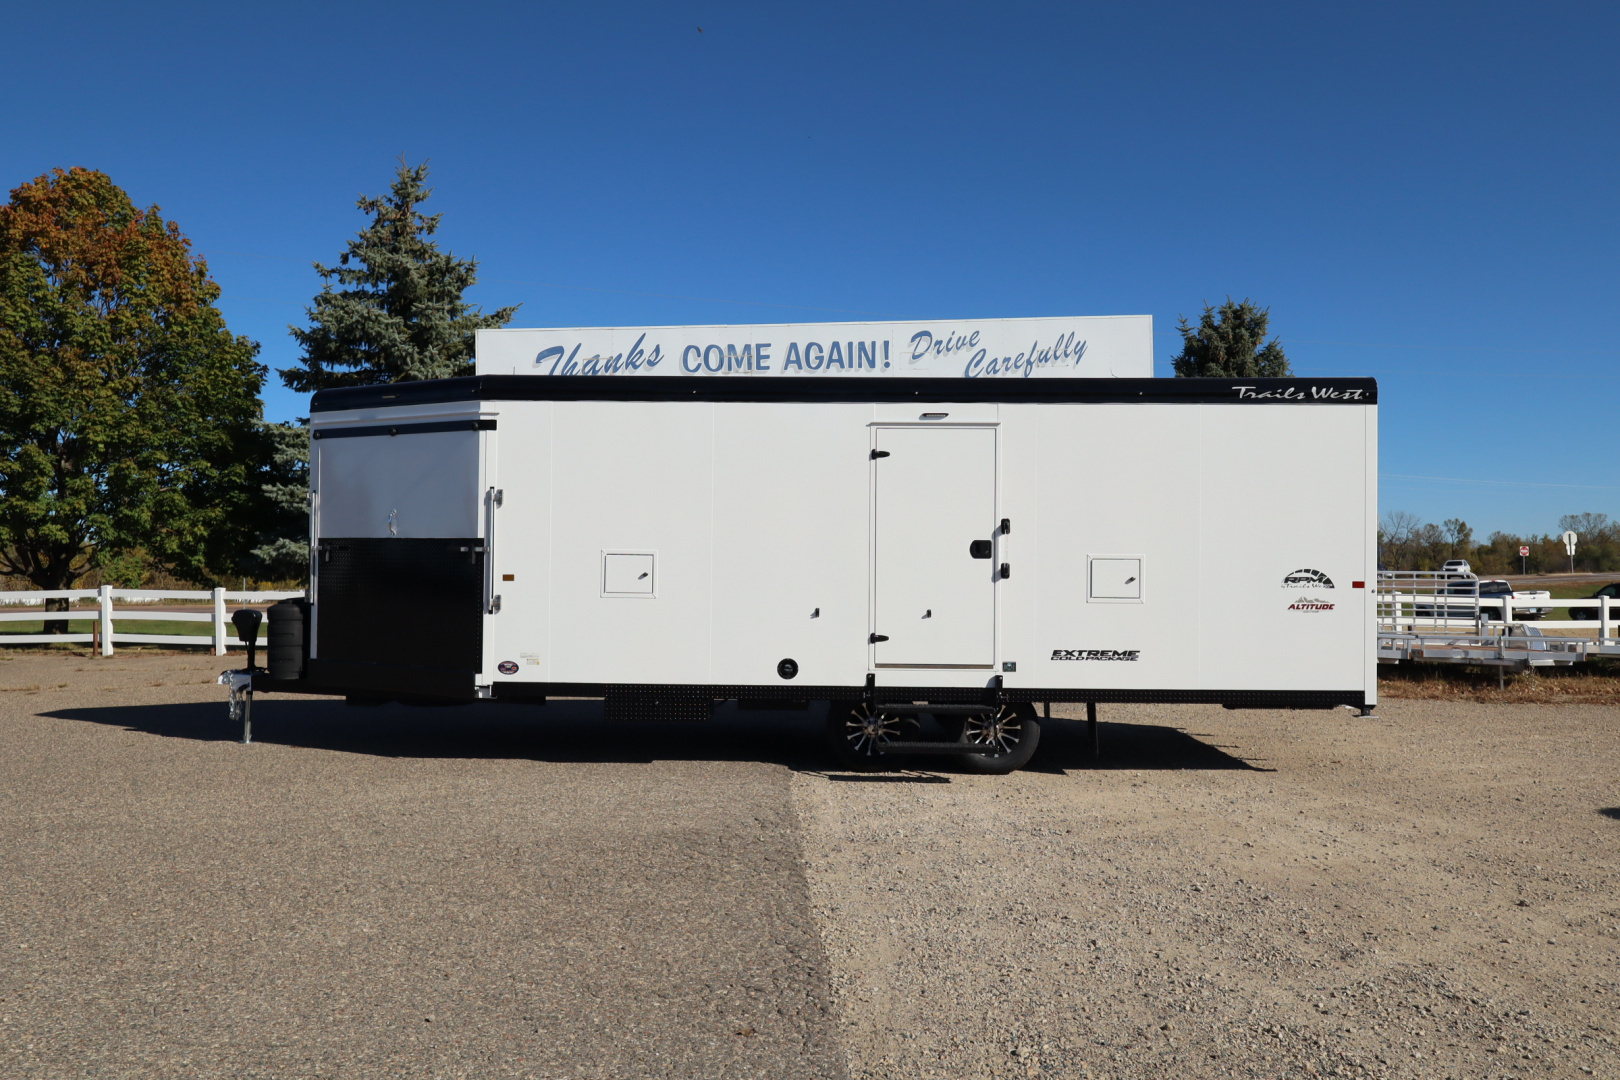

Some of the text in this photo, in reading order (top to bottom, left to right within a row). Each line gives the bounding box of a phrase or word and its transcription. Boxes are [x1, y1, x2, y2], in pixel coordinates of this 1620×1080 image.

[535, 333, 890, 376] Thanks COME AGAIN!
[910, 330, 980, 360] Drive
[964, 331, 1088, 378] Carefully
[1232, 386, 1363, 400] Trails West
[1284, 576, 1325, 584] RPM
[1052, 649, 1140, 657] EXTREME
